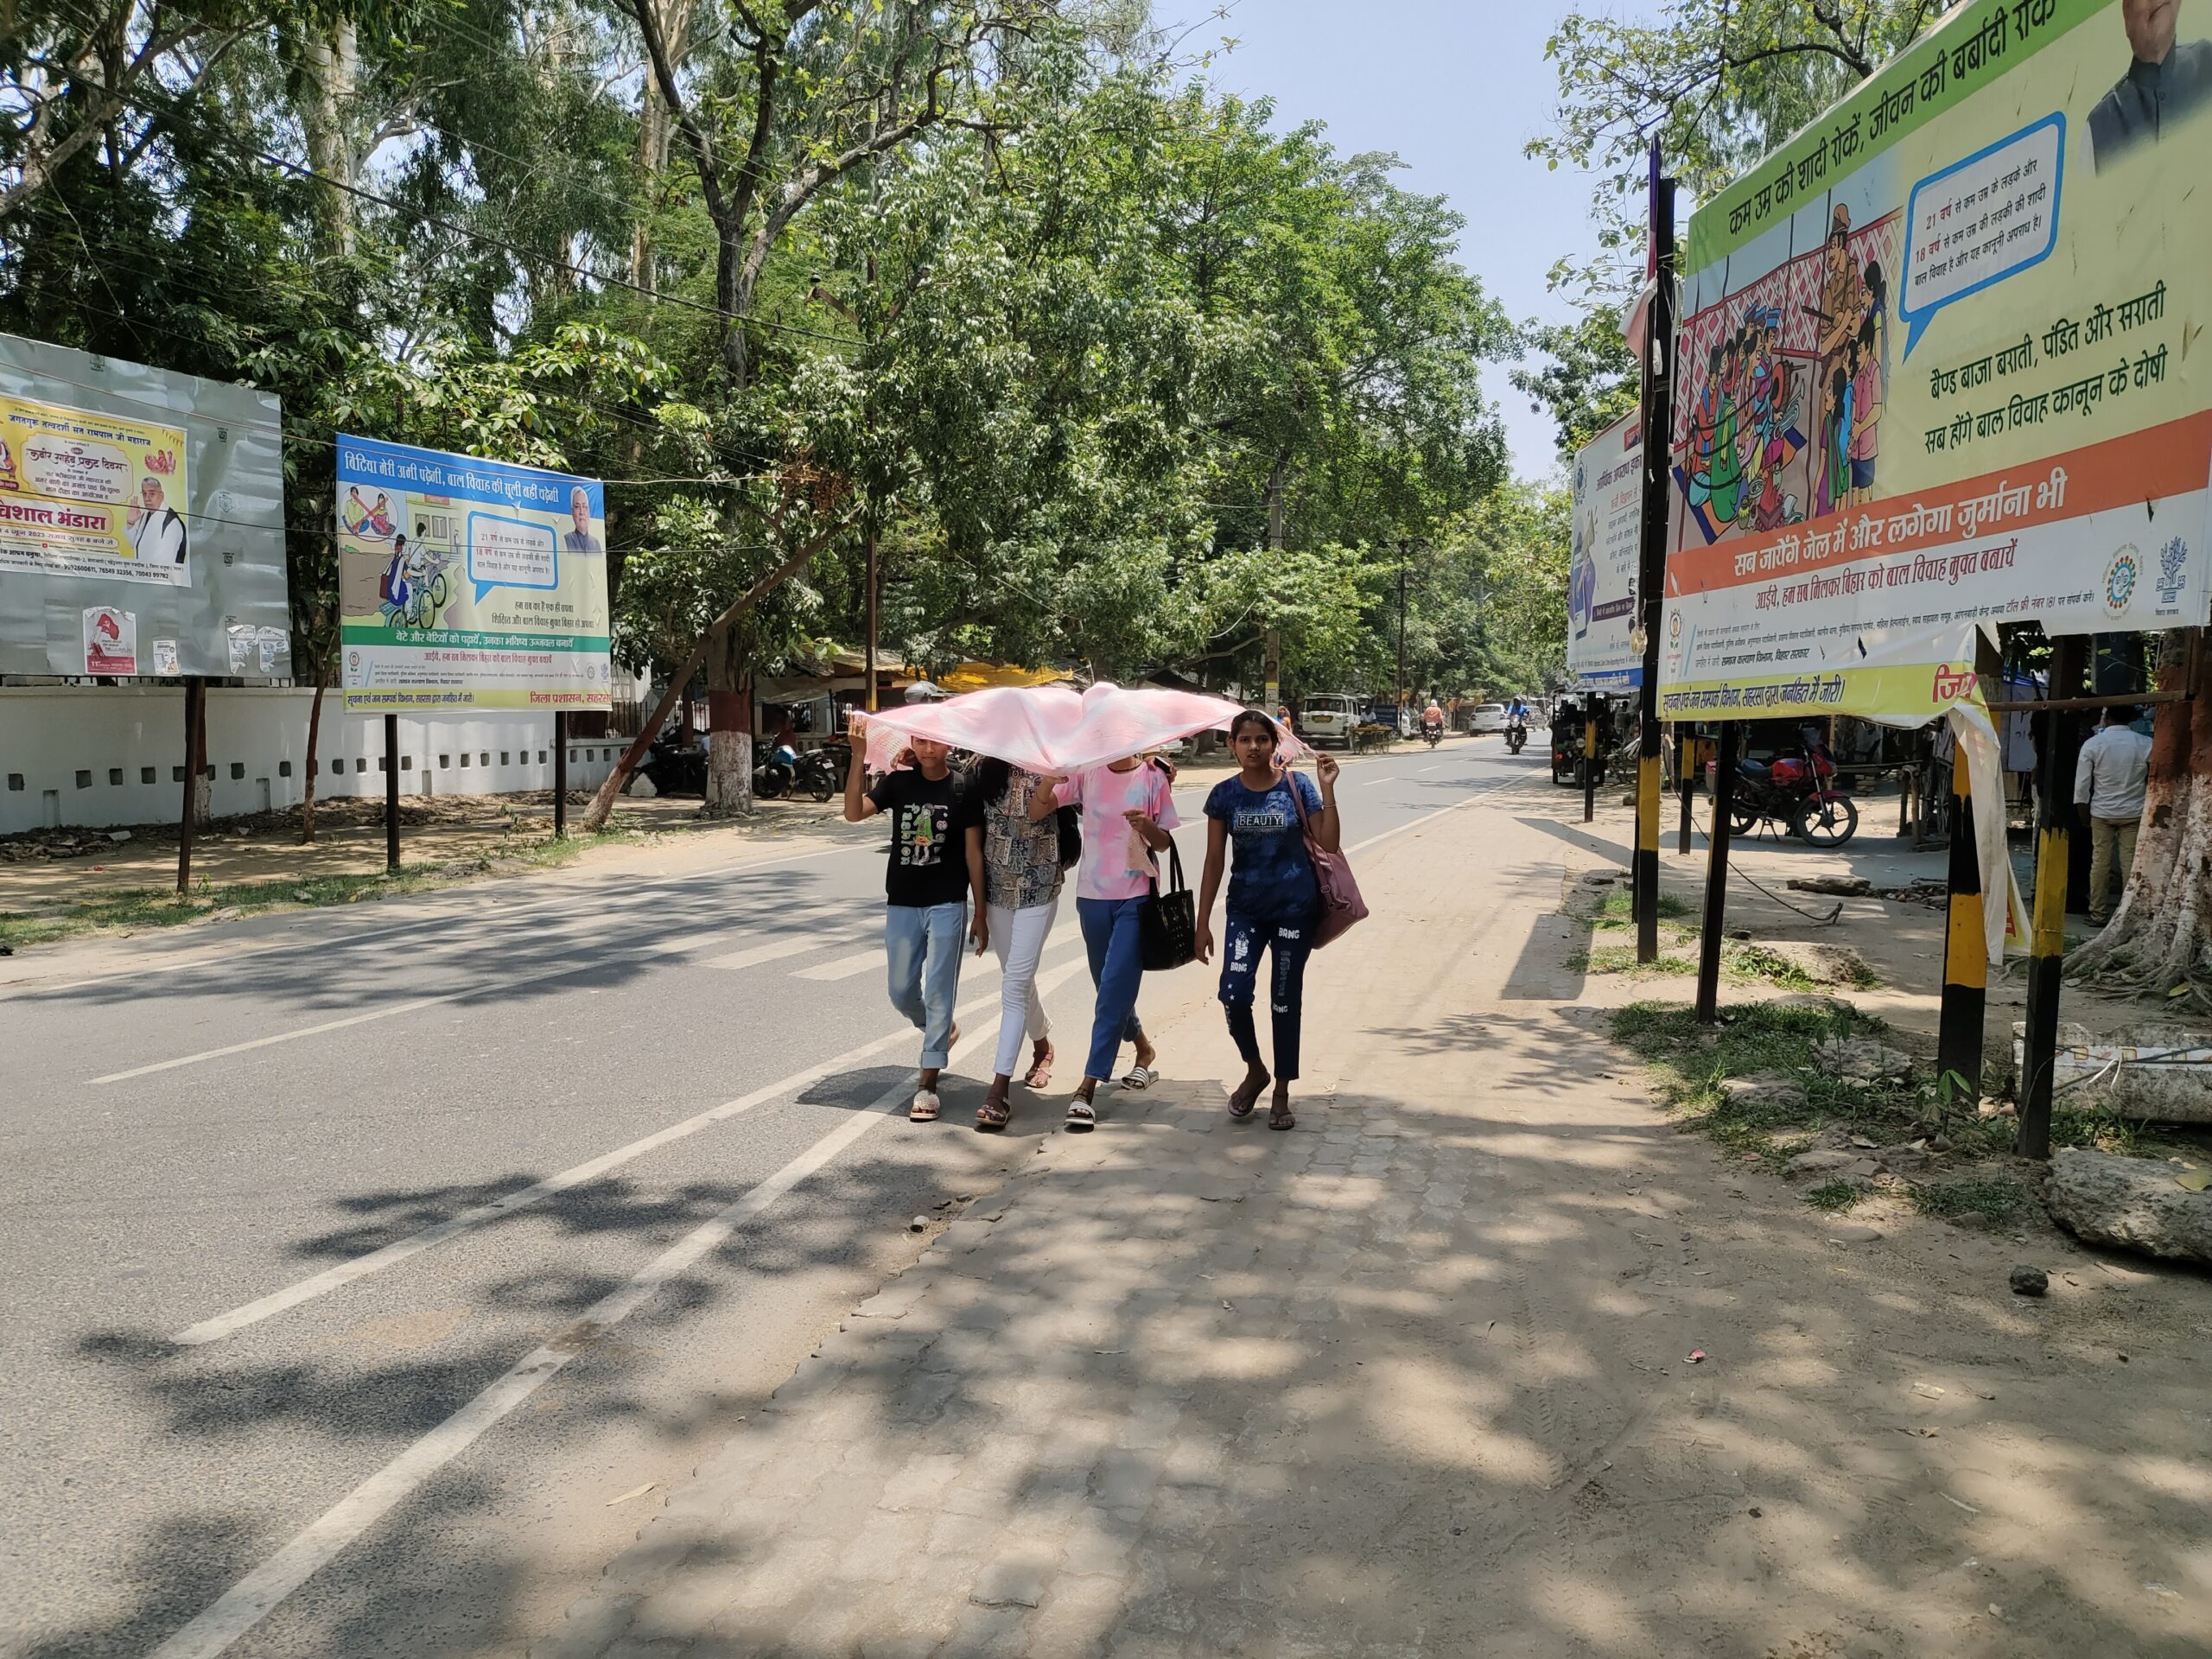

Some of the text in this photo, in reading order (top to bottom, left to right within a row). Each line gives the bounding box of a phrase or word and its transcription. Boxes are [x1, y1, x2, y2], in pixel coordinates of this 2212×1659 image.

[1729, 198, 1751, 235] कम
[1755, 184, 1771, 220] उम्र
[1775, 160, 1795, 205] की
[1797, 137, 1828, 191] शादी
[1831, 112, 1865, 167] रोकें,
[1869, 90, 1917, 140] जीवन
[1920, 48, 1948, 102] की
[1951, 6, 2008, 79] बर्बादी
[1926, 158, 2038, 230] 21 वर्ष से कम उम्र के लड़के और
[1915, 182, 2047, 264] 18 वर्ष से कम उम्र की लड़की की शादी
[1914, 271, 1927, 287] बाल
[1929, 261, 1947, 281] विवाह
[1948, 255, 1955, 273] है
[1955, 250, 1968, 270] और
[1970, 246, 1980, 261] यह
[1982, 229, 2005, 255] कानूनी
[2006, 220, 2031, 243] अपराध
[1929, 279, 2167, 400] बैण्ड बाजा बराती, पंडित और सराती
[1924, 343, 2168, 454] सब होंगे बाल विवाह कानून के दोषी
[86, 429, 113, 440] रामपाल
[115, 430, 125, 442] जी
[126, 435, 151, 447] महाराज
[77, 457, 100, 469] प्रकट
[102, 457, 127, 473] दिवस
[345, 451, 378, 474] बिटिया
[379, 459, 396, 477] मेरी
[448, 473, 465, 488] बाल
[467, 473, 491, 493] विवाह
[492, 478, 503, 494] की
[58, 508, 106, 530] भंडारा
[1734, 466, 2069, 577] सब जायेंगे जेल में और लगेगा जुर्माना भी
[1756, 538, 2018, 611] आईये, हम सब मिलकर बिहार को बाल विवाह मुक्त बनायें
[2006, 598, 2018, 613] टॉल
[2031, 594, 2044, 609] नंबर
[2057, 597, 2066, 607] पर
[2067, 590, 2082, 605] संपर्क
[396, 630, 409, 642] बेटे
[410, 630, 424, 643] और
[449, 632, 460, 644] को
[483, 636, 504, 646] उनका
[505, 635, 528, 646] भविष्य
[1775, 649, 1790, 661] बिहार
[1790, 648, 1810, 659] सरकार
[347, 695, 363, 708] सूचना
[372, 695, 381, 704] जन
[530, 690, 550, 703] जिला
[1690, 691, 1700, 709] जन
[1700, 683, 1723, 709] सम्पर्क
[1742, 685, 1766, 708] सहरसा
[1765, 685, 1780, 708] द्वारा
[1780, 677, 1810, 704] जनहित
[1808, 674, 1820, 702] में
[1239, 815, 1281, 826] BEAUTY
